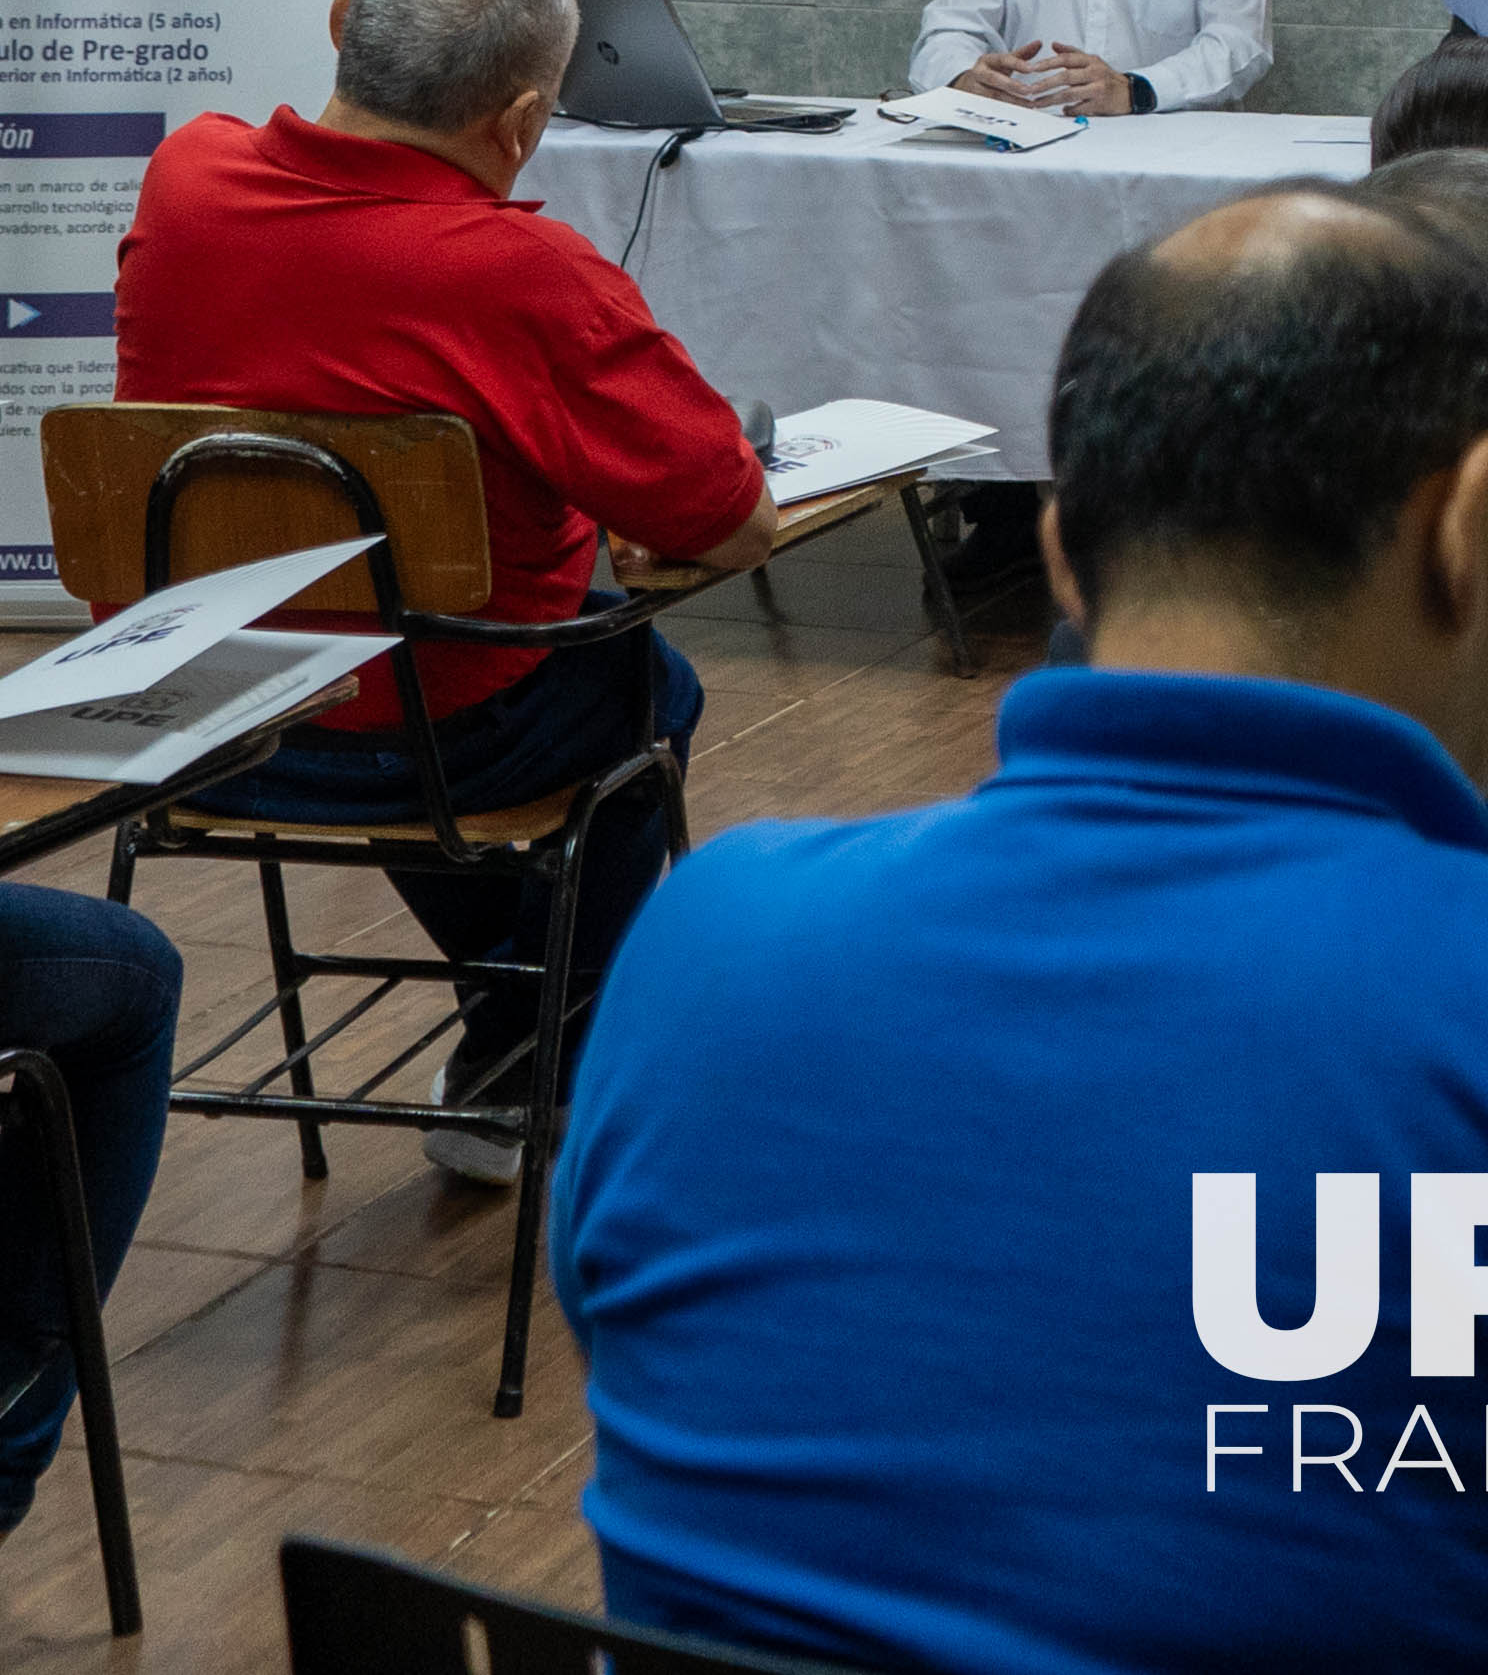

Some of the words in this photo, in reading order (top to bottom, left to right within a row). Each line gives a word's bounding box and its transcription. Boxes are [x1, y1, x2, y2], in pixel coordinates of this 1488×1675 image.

[8, 16, 32, 31] en
[35, 12, 143, 31] Informática
[148, 12, 167, 33] (5
[172, 12, 222, 33] años)
[41, 38, 74, 64] de
[82, 38, 210, 68] Pre-grado
[41, 71, 63, 84] en
[66, 66, 163, 84] Informática
[166, 66, 185, 86] (2
[188, 66, 233, 85] años)
[16, 182, 36, 194] un
[39, 181, 86, 194] marco
[90, 179, 110, 193] de
[52, 200, 135, 217] tecnológico
[66, 221, 115, 235] acorde
[46, 362, 75, 378] que
[30, 383, 57, 395] con
[62, 381, 76, 395] la
[5, 403, 24, 417] de
[69, 705, 179, 727] UPE
